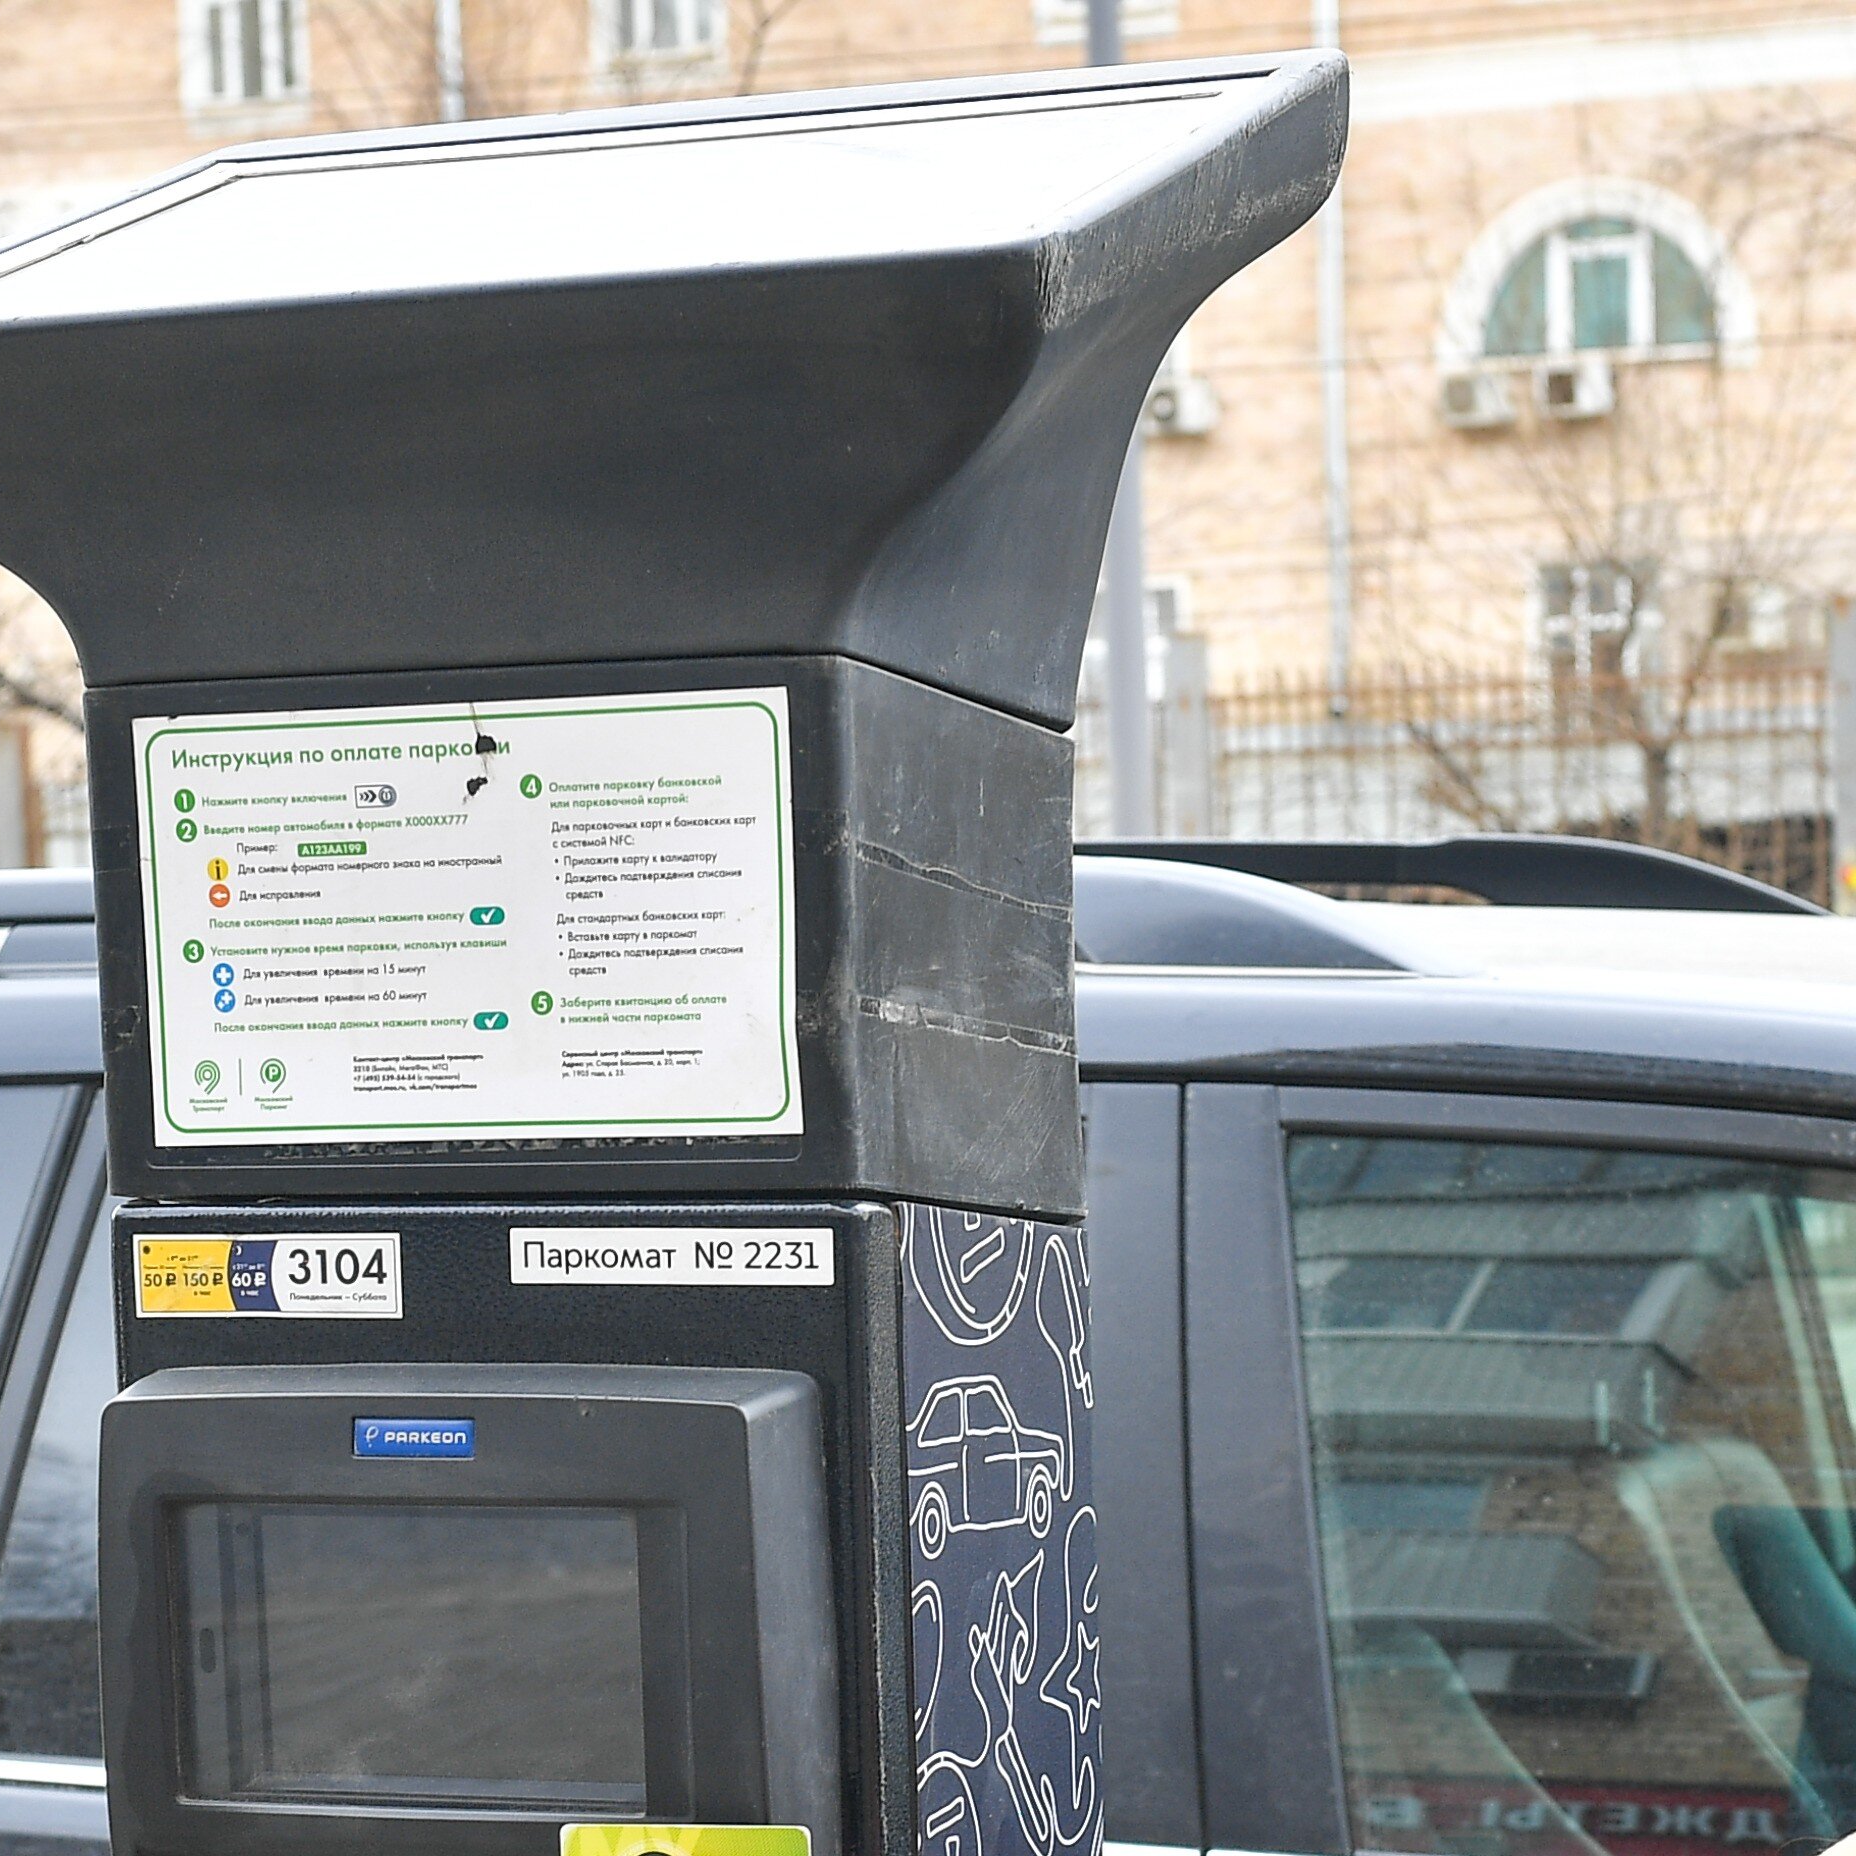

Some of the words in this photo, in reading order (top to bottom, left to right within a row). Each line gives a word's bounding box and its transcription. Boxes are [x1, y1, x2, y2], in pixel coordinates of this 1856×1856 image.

[172, 749, 292, 772] Инструкция
[300, 750, 323, 763] по
[331, 746, 401, 761] оплате
[409, 741, 510, 760] паркои
[524, 779, 537, 795] 4
[549, 782, 600, 792] Оплатите
[603, 780, 655, 792] парковку
[658, 775, 721, 787] банковской
[181, 792, 188, 810] 1
[202, 796, 248, 807] Нажмите
[251, 796, 288, 806] кнопку
[291, 794, 347, 803] включения
[572, 794, 644, 810] парковочной
[647, 793, 688, 807] картой:
[181, 823, 193, 839] 2
[203, 824, 245, 835] Введите
[248, 825, 280, 835] номер
[283, 820, 345, 831] автомобиля
[356, 818, 402, 831] формате
[405, 814, 468, 827] Х000ХХ777
[551, 821, 570, 833] Для
[572, 822, 637, 833] парковочных
[640, 820, 662, 831] карт
[674, 816, 731, 827] банковских
[734, 816, 756, 827] карт
[237, 842, 277, 855] Пример:
[560, 836, 606, 848] системой
[238, 864, 255, 875] Для
[291, 862, 334, 875] формата
[337, 861, 389, 872] номерного
[438, 855, 502, 868] иностранный
[564, 855, 619, 868] Приложите
[622, 855, 649, 866] карту
[660, 853, 717, 863] валидатору
[564, 872, 617, 884] Дождитесь
[620, 871, 694, 882] подтверждения
[239, 890, 257, 901] Для
[260, 890, 320, 902] исправления
[566, 891, 603, 901] средств
[209, 918, 240, 928] После
[244, 918, 300, 927] окончания
[303, 917, 333, 926] ввода
[335, 915, 376, 924] данных
[427, 912, 464, 922] кнопку
[556, 913, 574, 925] Для
[577, 914, 639, 925] стандартных
[642, 910, 698, 921] банковских
[568, 931, 609, 941] Вставьте
[613, 932, 640, 942] карту
[651, 930, 697, 941] паркомат
[188, 944, 199, 959] 3
[210, 946, 268, 956] Установите
[271, 946, 310, 957] нужное
[314, 945, 344, 955] время
[404, 941, 457, 951] используя
[568, 948, 621, 960] Дождитесь
[624, 948, 697, 959] подтверждения
[243, 968, 261, 979] Для
[263, 970, 317, 981] увеличения
[323, 968, 364, 978] времени
[383, 963, 394, 974] 15
[398, 966, 426, 976] минут
[569, 967, 606, 977] средств
[244, 994, 262, 1005] Для
[264, 996, 318, 1007] увеличения
[324, 995, 365, 1004] времени
[382, 990, 396, 1000] 60
[399, 992, 427, 1002] минут
[537, 995, 547, 1011] 5
[560, 996, 611, 1009] Заберите
[675, 993, 688, 1004] об
[214, 1022, 245, 1032] После
[248, 1023, 304, 1031] окончания
[307, 1022, 337, 1030] ввода
[339, 1021, 379, 1029] данных
[431, 1018, 468, 1028] кнопку
[568, 1012, 609, 1023] нижней
[644, 1013, 701, 1024] паркомата
[524, 1242, 676, 1274] Паркомат
[694, 1242, 733, 1269] №
[745, 1242, 818, 1269] 2231
[289, 1248, 387, 1285] 3104
[144, 1274, 162, 1286] 50
[185, 1273, 209, 1286] 150
[232, 1273, 251, 1287] 60
[290, 1293, 342, 1301] Понедельник
[352, 1293, 387, 1302] Суббота
[385, 1430, 467, 1444] PARKEON
